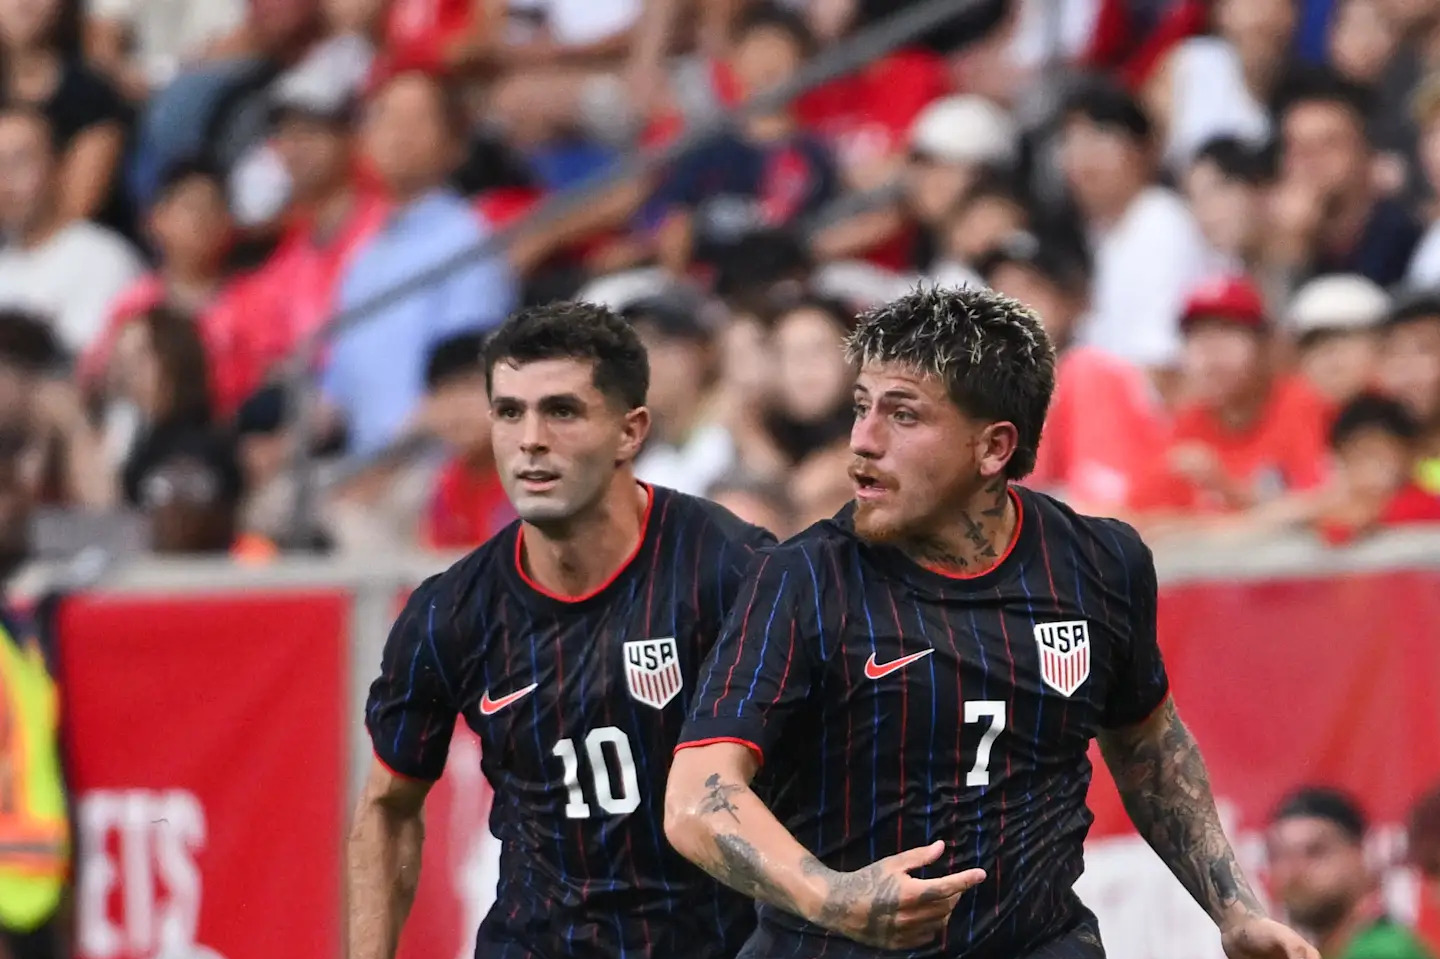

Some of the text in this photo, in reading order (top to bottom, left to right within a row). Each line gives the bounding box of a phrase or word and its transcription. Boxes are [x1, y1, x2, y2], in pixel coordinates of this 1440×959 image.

[629, 642, 674, 670] USA
[1041, 625, 1085, 653] USA
[964, 700, 1006, 787] 7
[552, 726, 641, 819] 10
